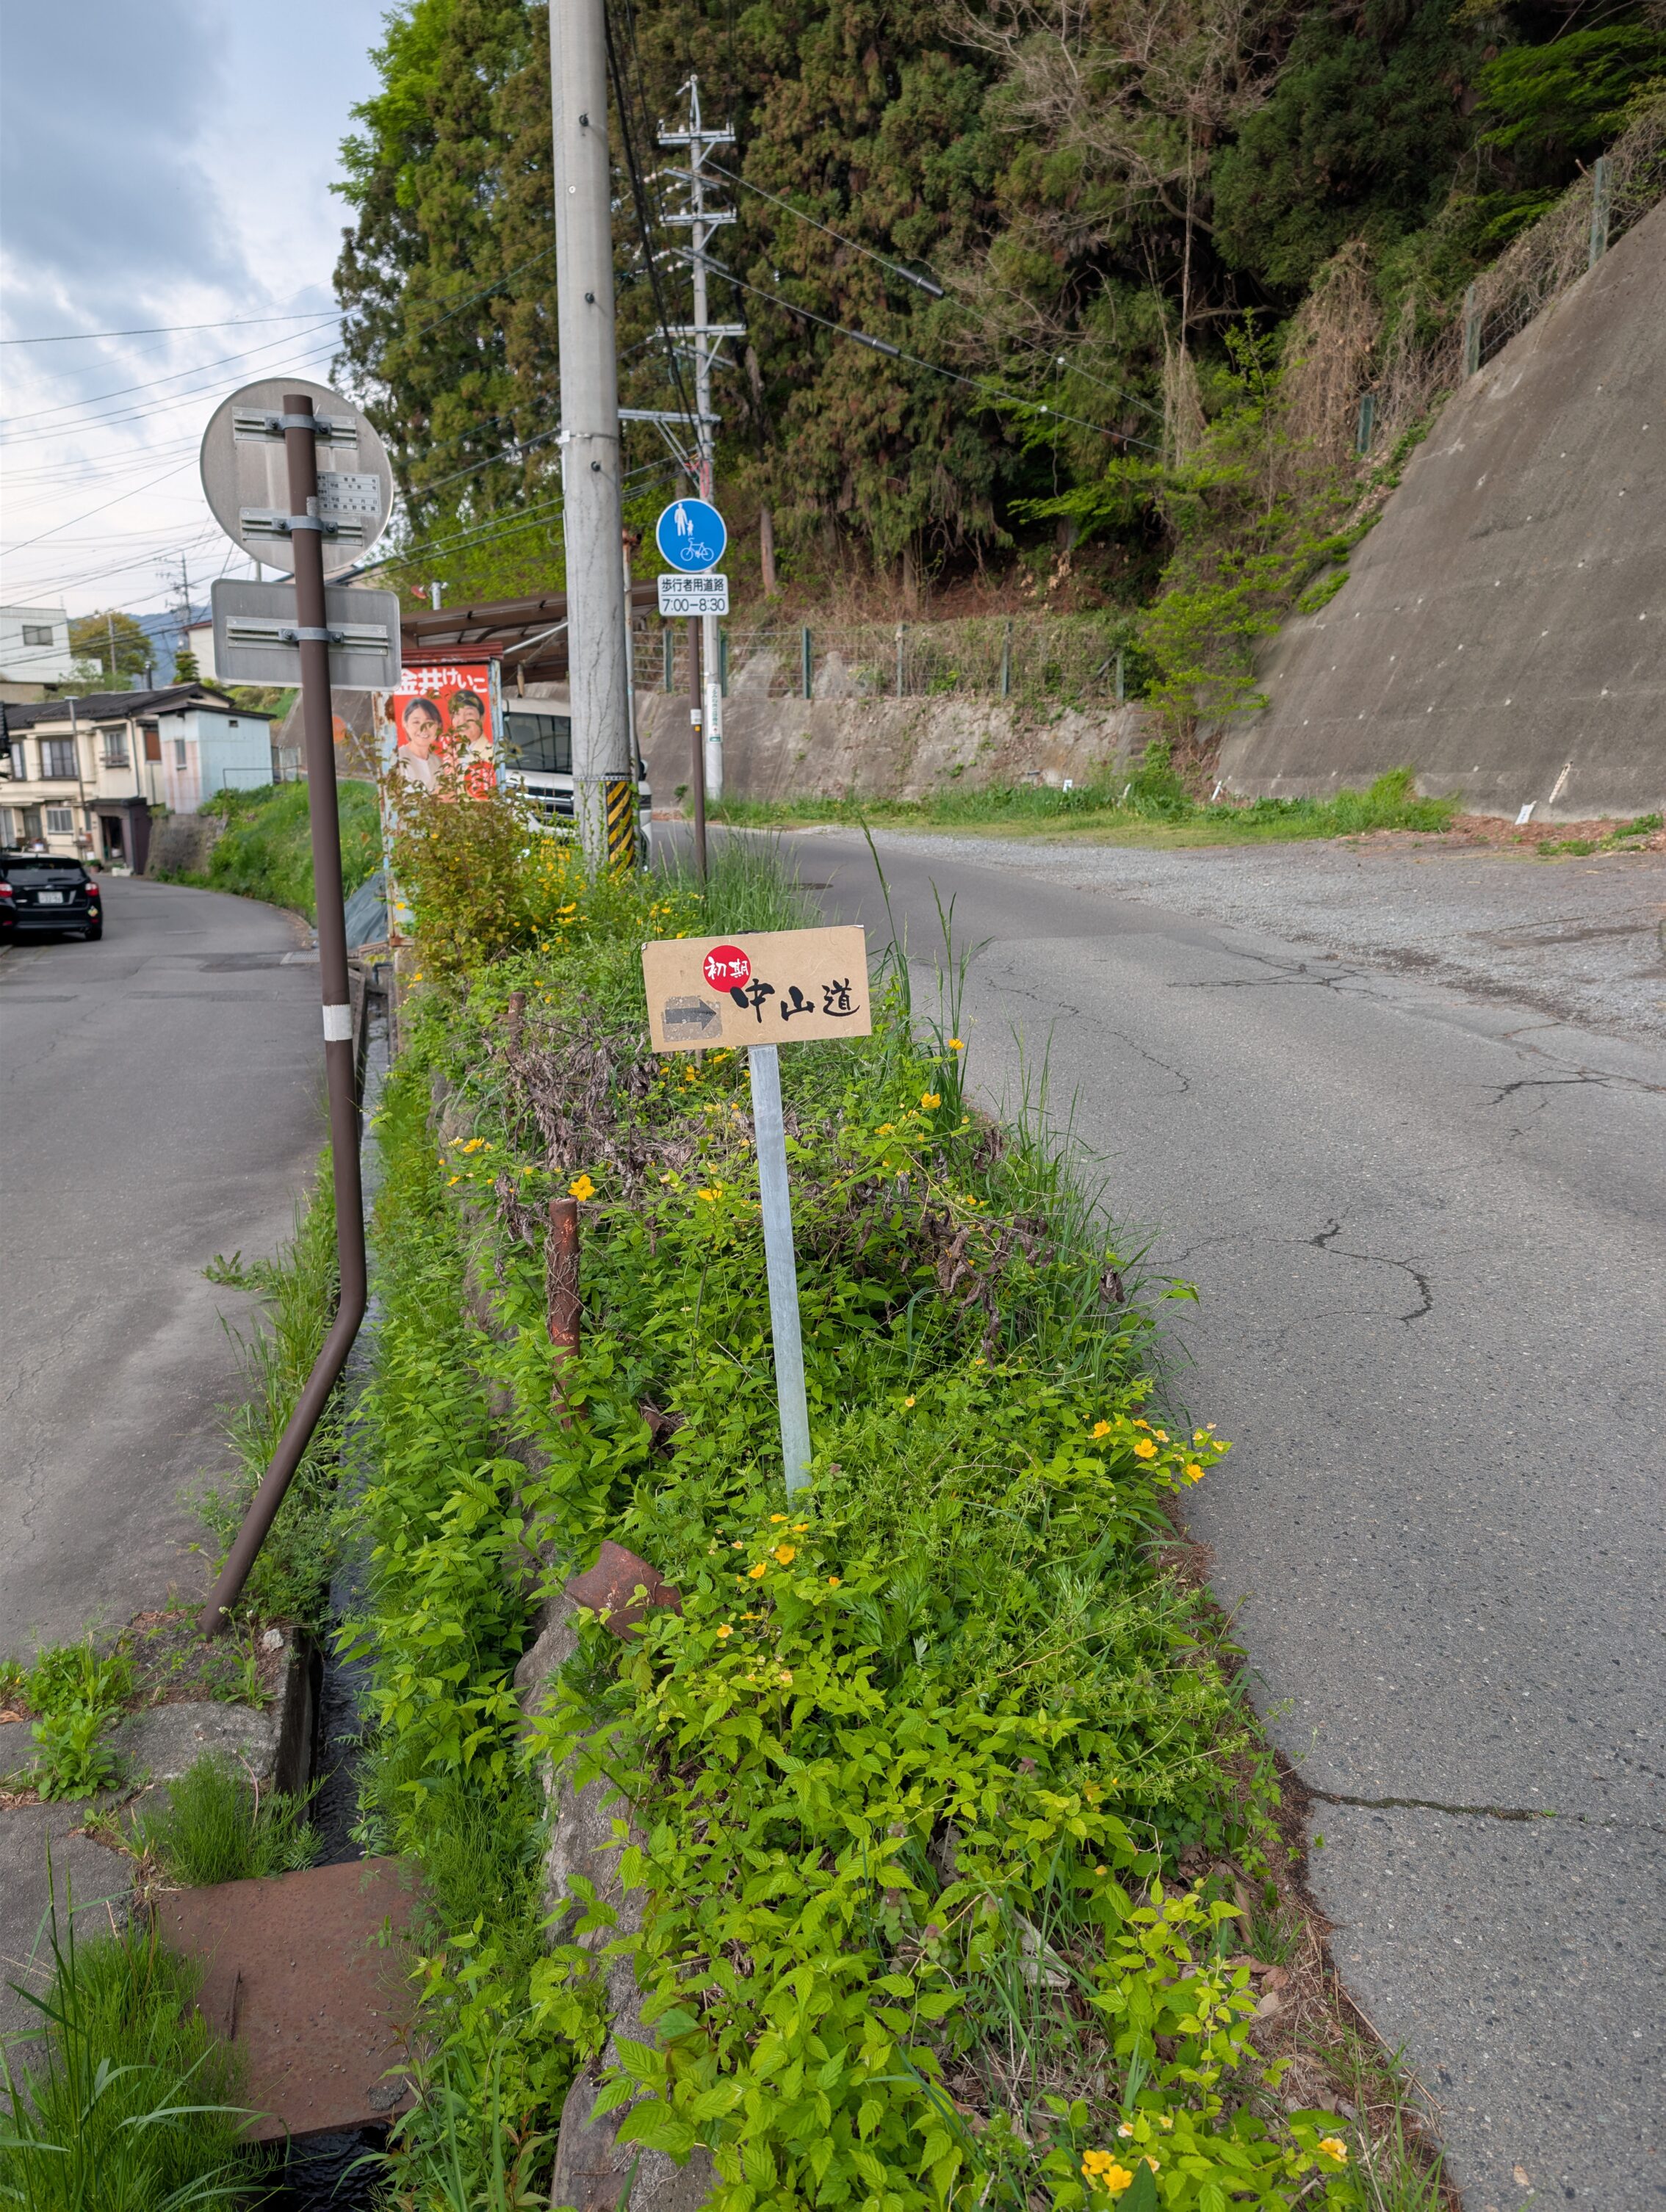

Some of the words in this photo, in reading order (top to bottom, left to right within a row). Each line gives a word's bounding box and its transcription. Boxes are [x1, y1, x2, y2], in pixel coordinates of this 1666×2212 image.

[662, 578, 724, 593] 歩行者用道路
[394, 668, 488, 695] 金井けいこ
[704, 955, 749, 980] 初期
[729, 977, 860, 1024] 中山道
